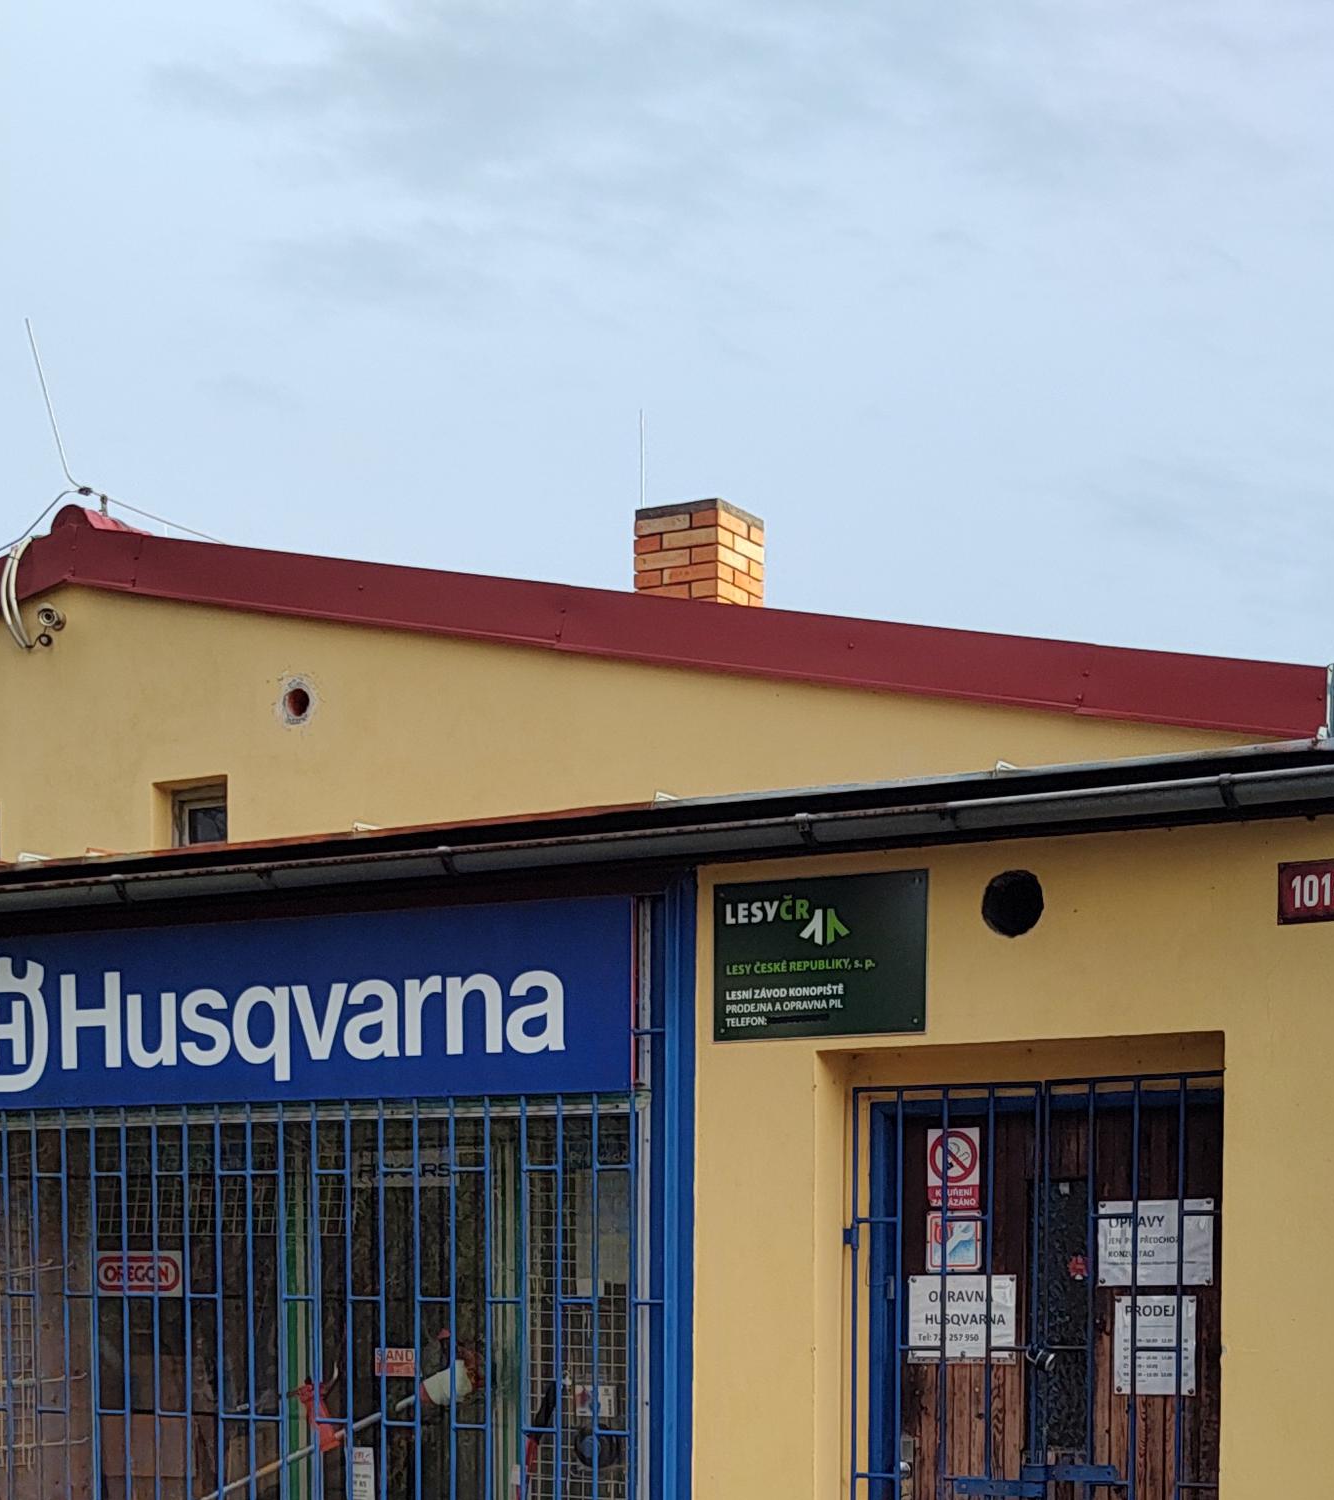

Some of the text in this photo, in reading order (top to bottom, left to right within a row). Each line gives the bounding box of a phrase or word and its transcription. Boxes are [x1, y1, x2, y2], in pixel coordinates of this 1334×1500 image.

[726, 958, 876, 976] LESY ČESKÉ REPUBLIKY, s. p.
[726, 983, 844, 1001] LESNÍ ZÁVOD KONOPIŠTĚ
[725, 998, 844, 1014] PRODEJNA A OPRAVNA PIL
[60, 970, 566, 1082] Husqvarna
[725, 1016, 768, 1028] TELEFON:
[935, 1188, 973, 1198] KUŘENÍ
[918, 1332, 932, 1342] Tel:
[949, 1333, 963, 1342] 257
